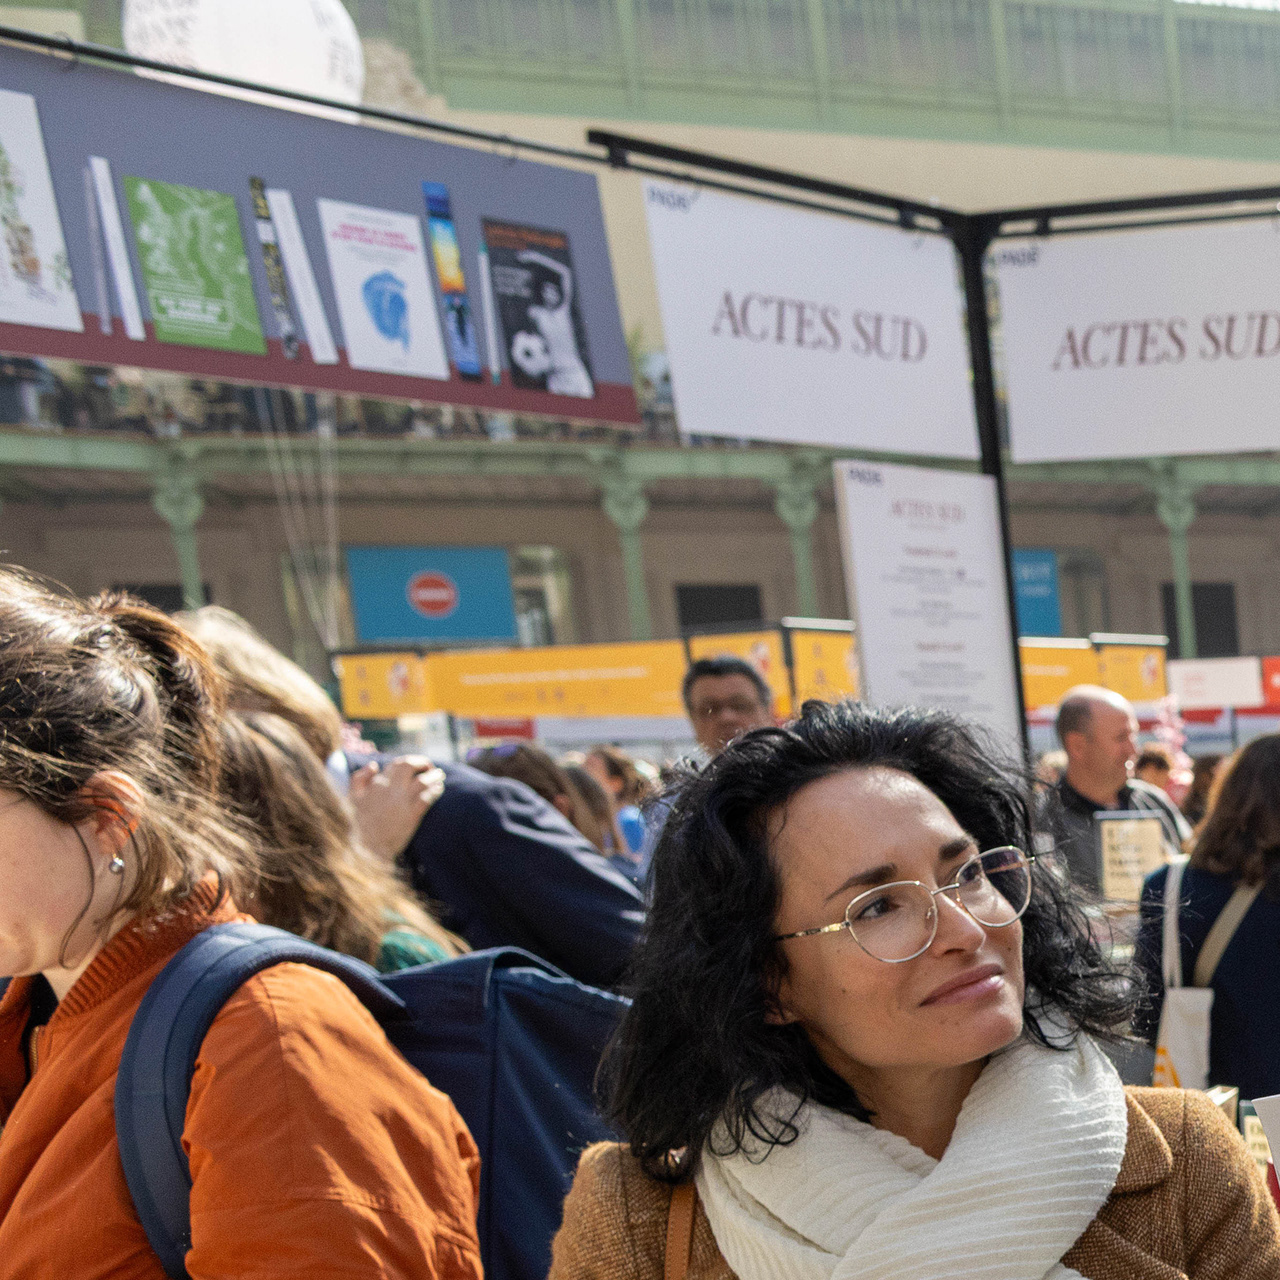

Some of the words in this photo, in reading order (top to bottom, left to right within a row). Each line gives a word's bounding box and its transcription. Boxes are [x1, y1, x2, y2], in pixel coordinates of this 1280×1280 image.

[711, 290, 842, 352] ACTES
[851, 308, 928, 365] SUD
[1051, 316, 1188, 371] ACTES
